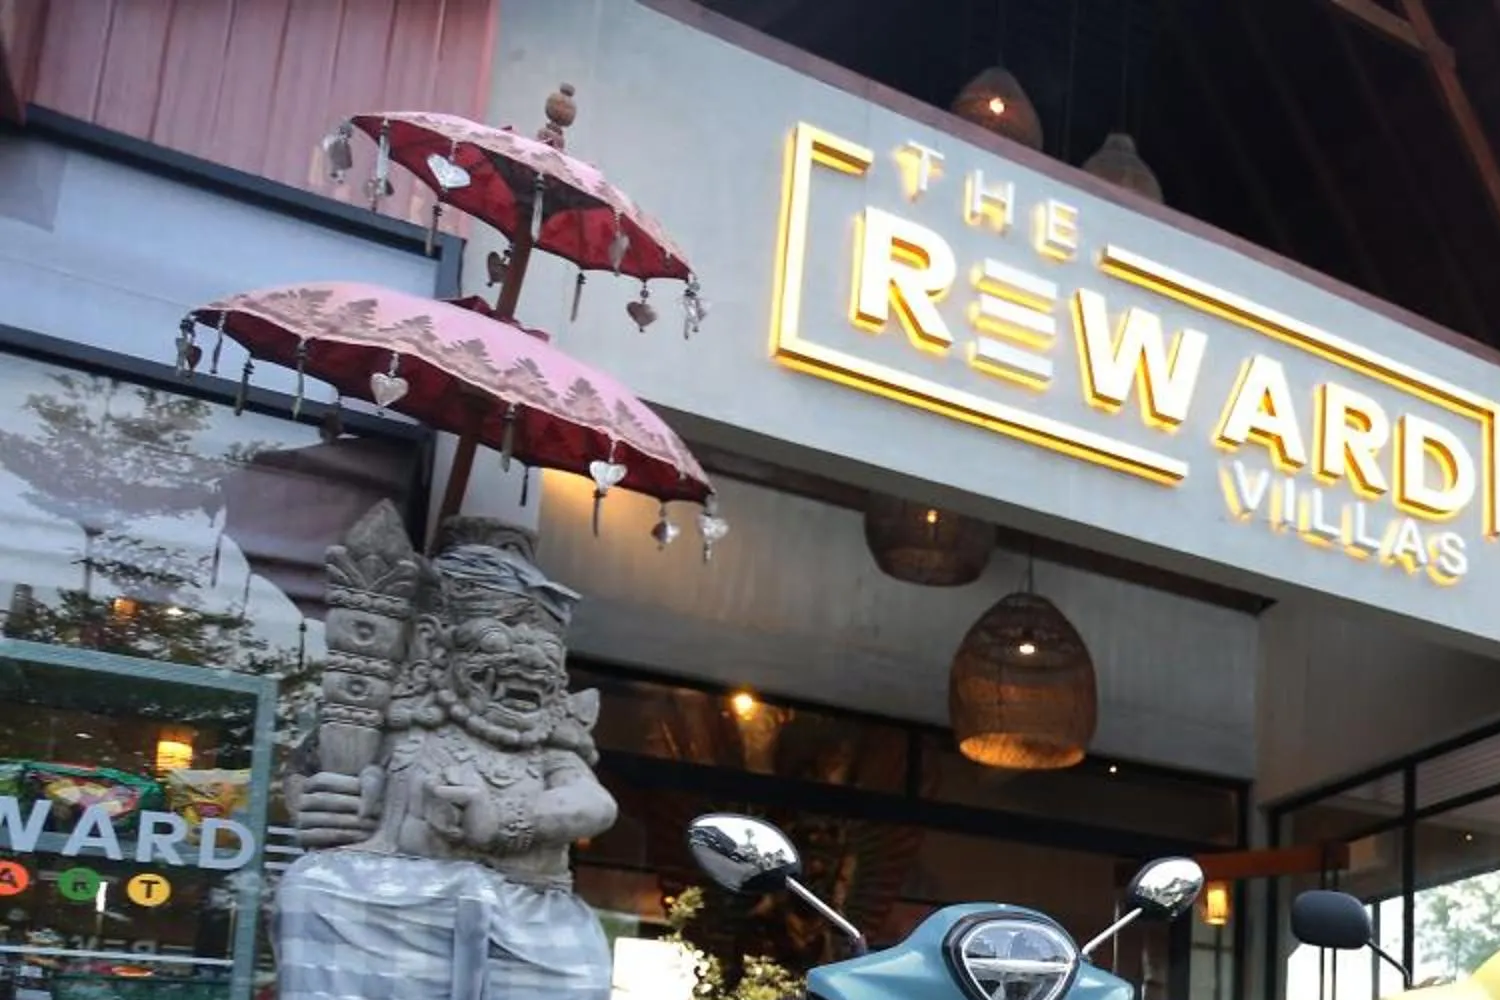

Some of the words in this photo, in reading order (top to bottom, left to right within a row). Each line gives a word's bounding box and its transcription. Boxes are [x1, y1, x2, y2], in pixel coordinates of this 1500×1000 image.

[896, 138, 1081, 263] THE
[848, 204, 1477, 521] REWARD
[1220, 458, 1470, 587] VILLAS
